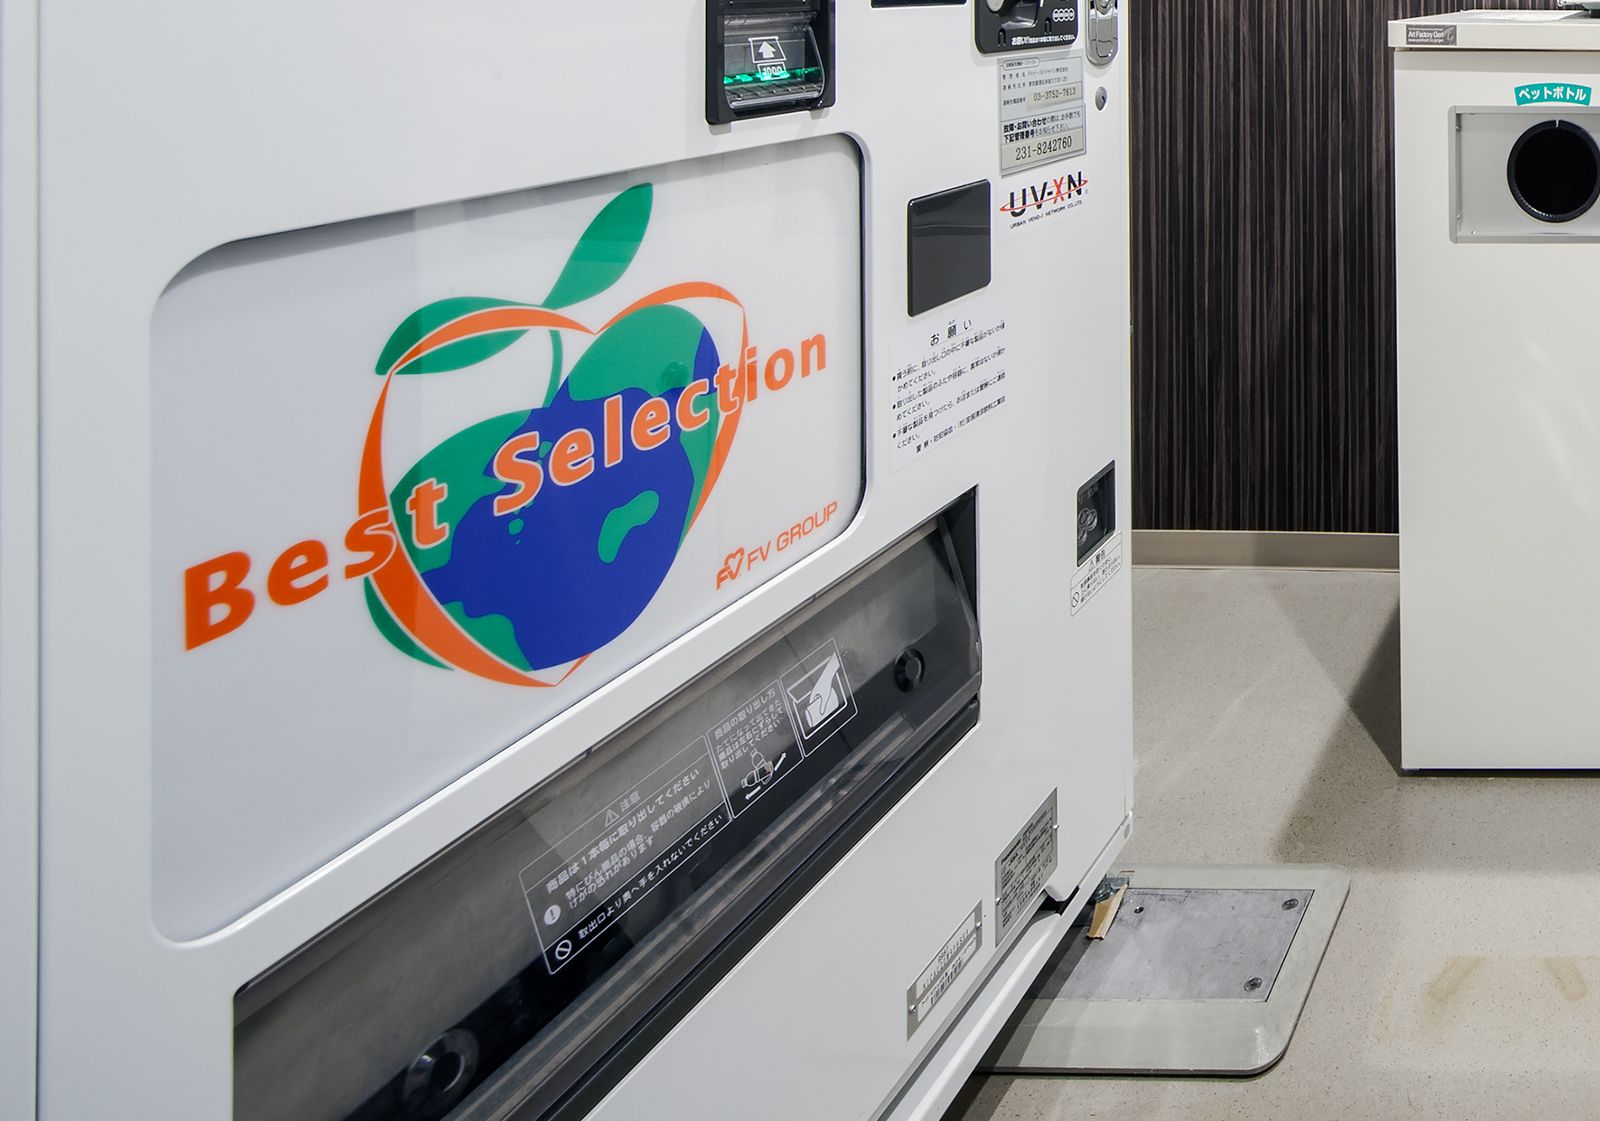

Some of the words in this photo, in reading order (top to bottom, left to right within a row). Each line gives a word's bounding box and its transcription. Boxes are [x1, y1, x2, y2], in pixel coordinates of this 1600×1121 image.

[1518, 85, 1587, 102] ペットボトル
[1015, 135, 1073, 162] 231-8242760
[185, 478, 449, 653] Best
[492, 332, 828, 517] Selection
[746, 543, 772, 573] FV
[776, 500, 839, 554] GROUP
